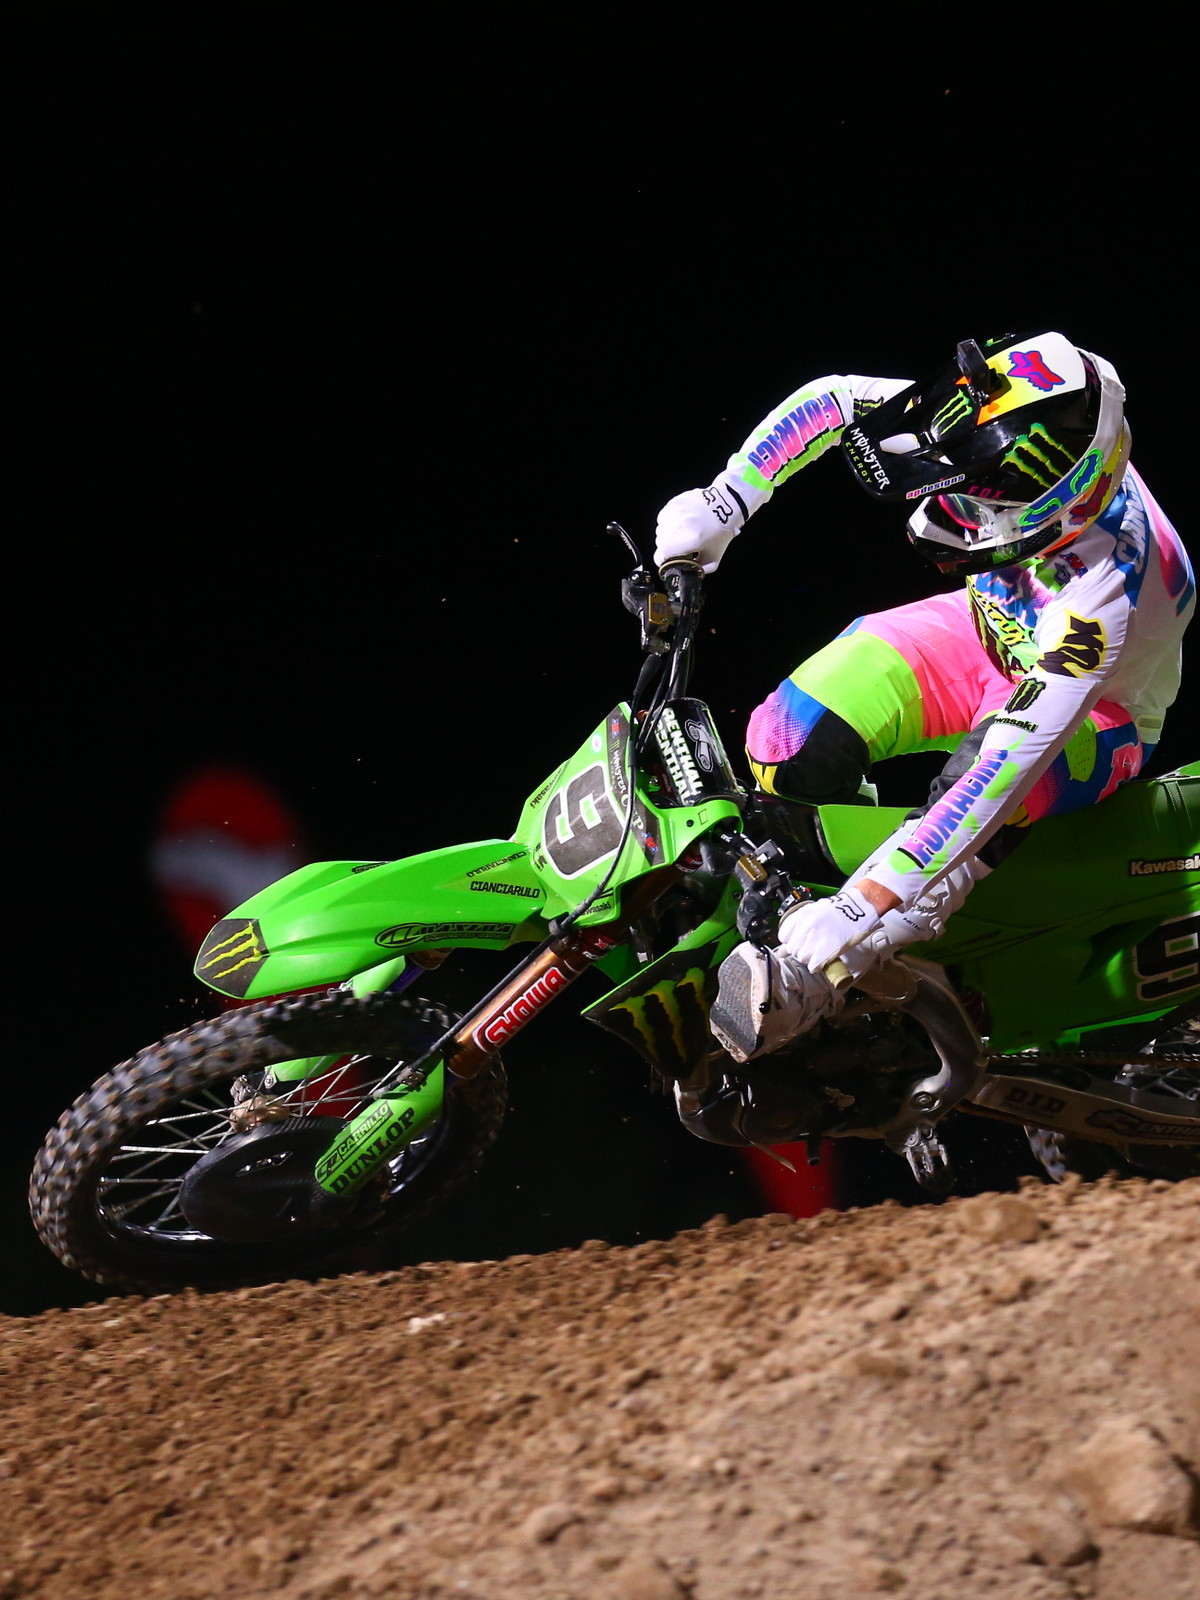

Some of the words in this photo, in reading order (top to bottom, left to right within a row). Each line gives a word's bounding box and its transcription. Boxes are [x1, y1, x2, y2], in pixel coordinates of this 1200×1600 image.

[844, 442, 872, 484] ENERGY
[850, 427, 891, 490] MONSTER
[906, 474, 966, 500] apdesigns
[967, 485, 1006, 499] FOX
[992, 716, 1039, 734] wasaki
[612, 750, 628, 798] MONSTER
[661, 706, 705, 796] RENTHAL
[469, 880, 541, 899] CIANCIARULO
[484, 966, 570, 1048] SHOWA
[328, 1107, 415, 1194] DUNLOP
[338, 1103, 390, 1156] CARRILLO
